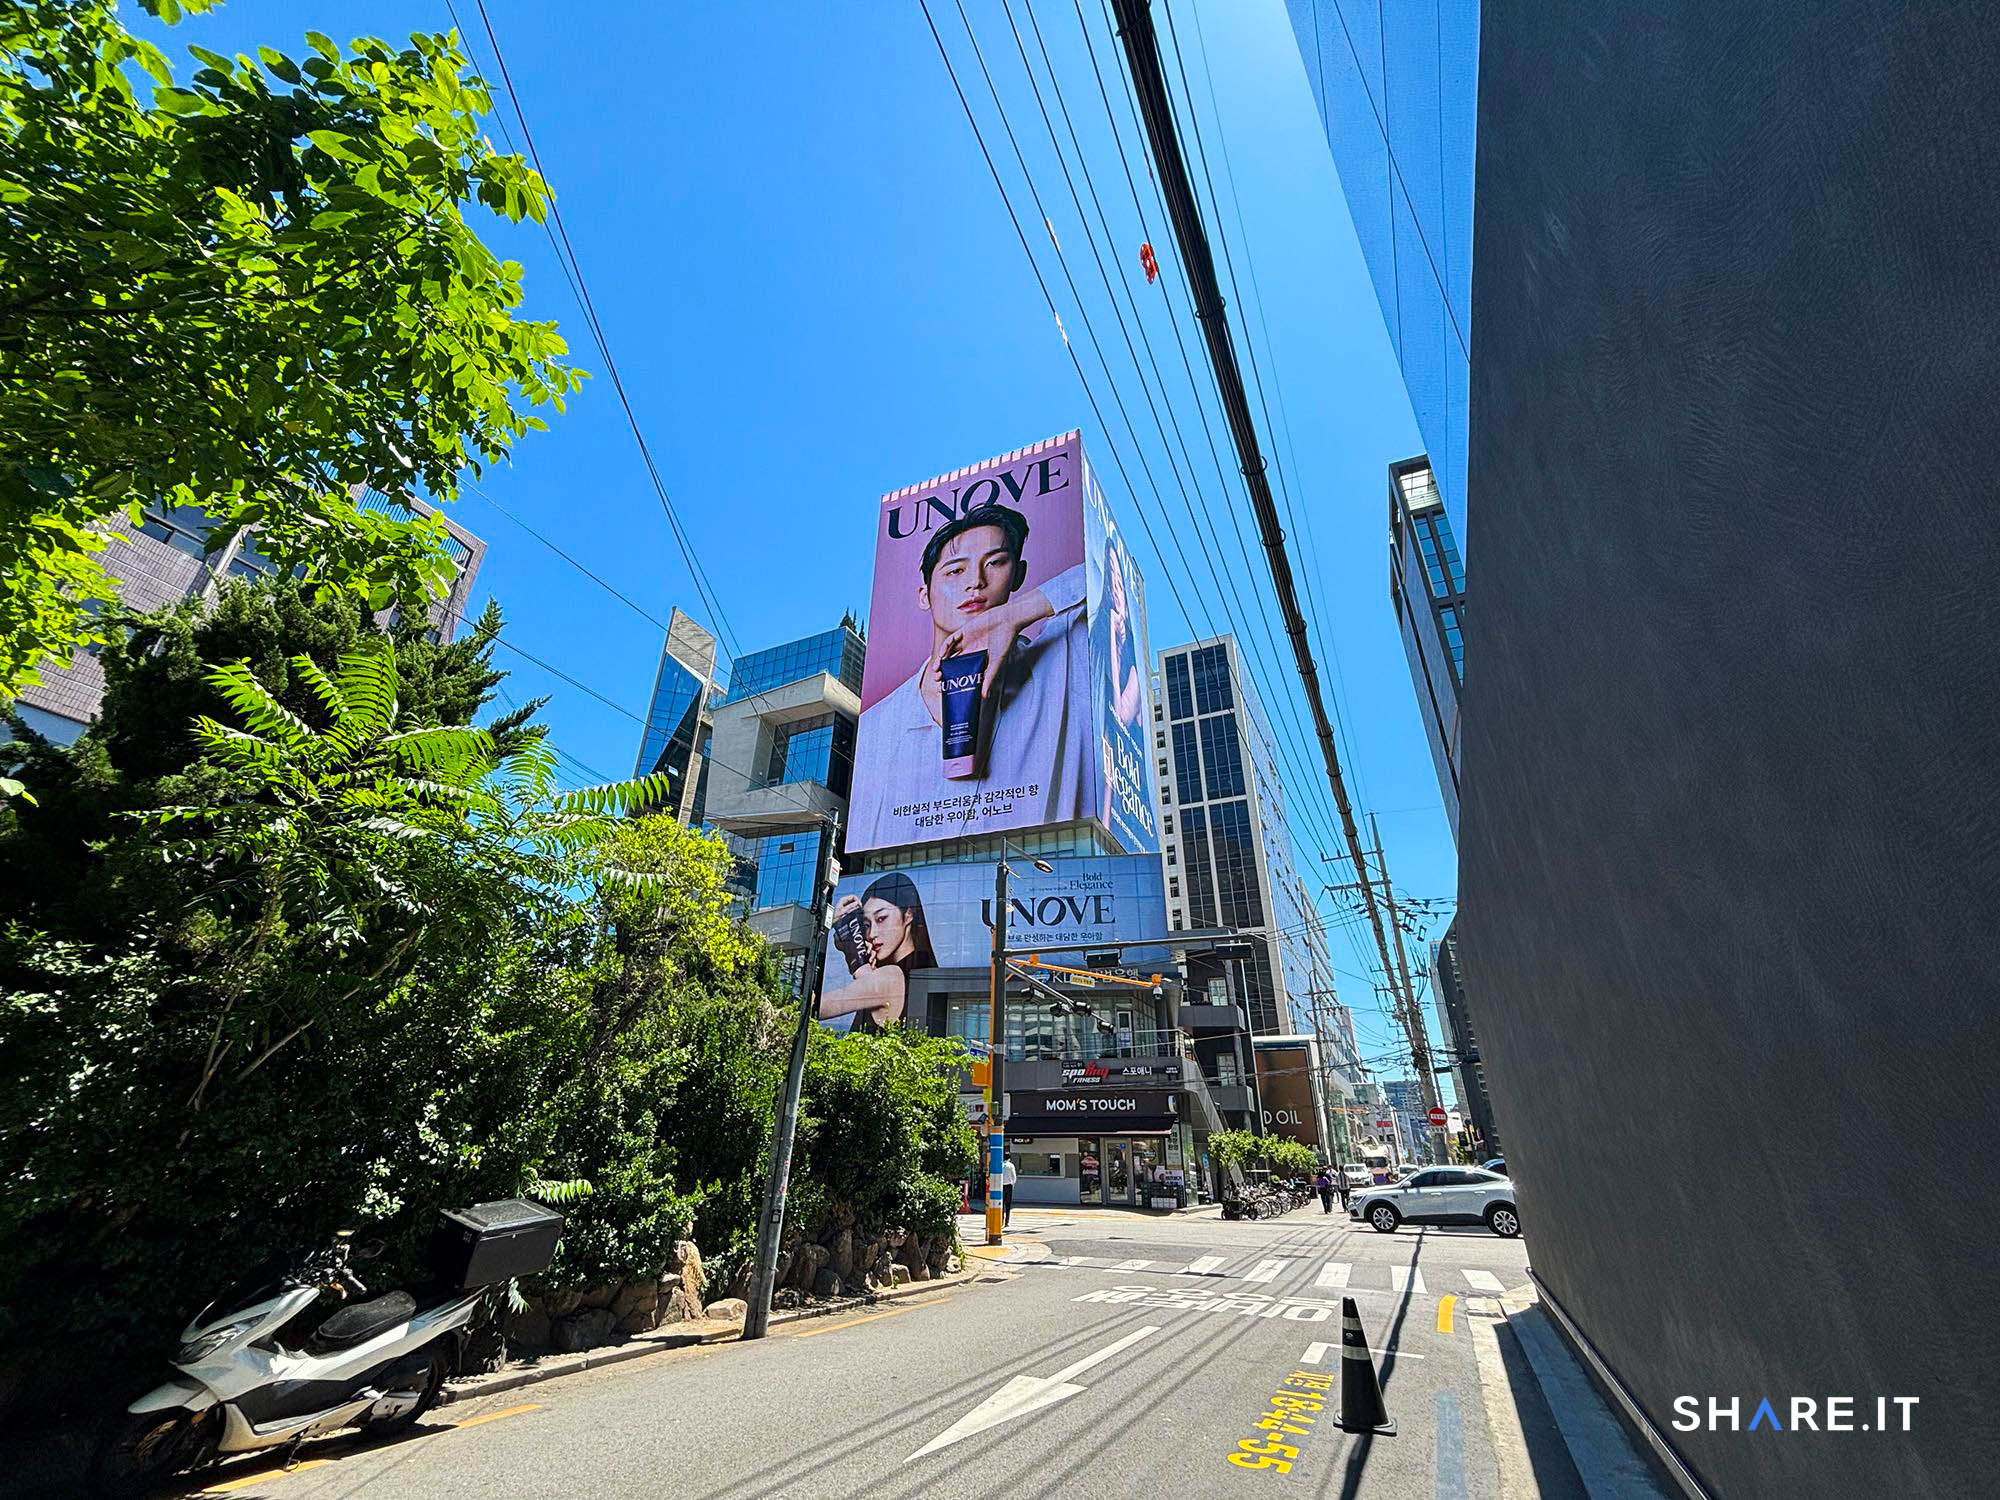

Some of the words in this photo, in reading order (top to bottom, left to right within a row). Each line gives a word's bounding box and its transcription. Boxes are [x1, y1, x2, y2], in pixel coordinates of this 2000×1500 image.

[887, 452, 1070, 539] UNOVE
[1116, 731, 1141, 791] Bold
[893, 801, 930, 817] 비현실적
[933, 793, 982, 811] 부드러움과
[984, 786, 1026, 803] 감각적인
[1102, 735, 1154, 838] Elegance
[915, 814, 944, 827] 대담한
[982, 803, 1013, 817] 어노브
[1070, 880, 1114, 891] Elegance
[1082, 872, 1102, 881] Bold
[981, 894, 1116, 928] UNOVE
[849, 916, 867, 959] UNOVE
[1122, 1066, 1153, 1076] 스포애니
[1046, 1098, 1087, 1111] MOM'S
[1090, 1099, 1136, 1111] TOUCH
[1276, 1110, 1303, 1125] OIL
[1071, 1285, 1340, 1321] 일방통행
